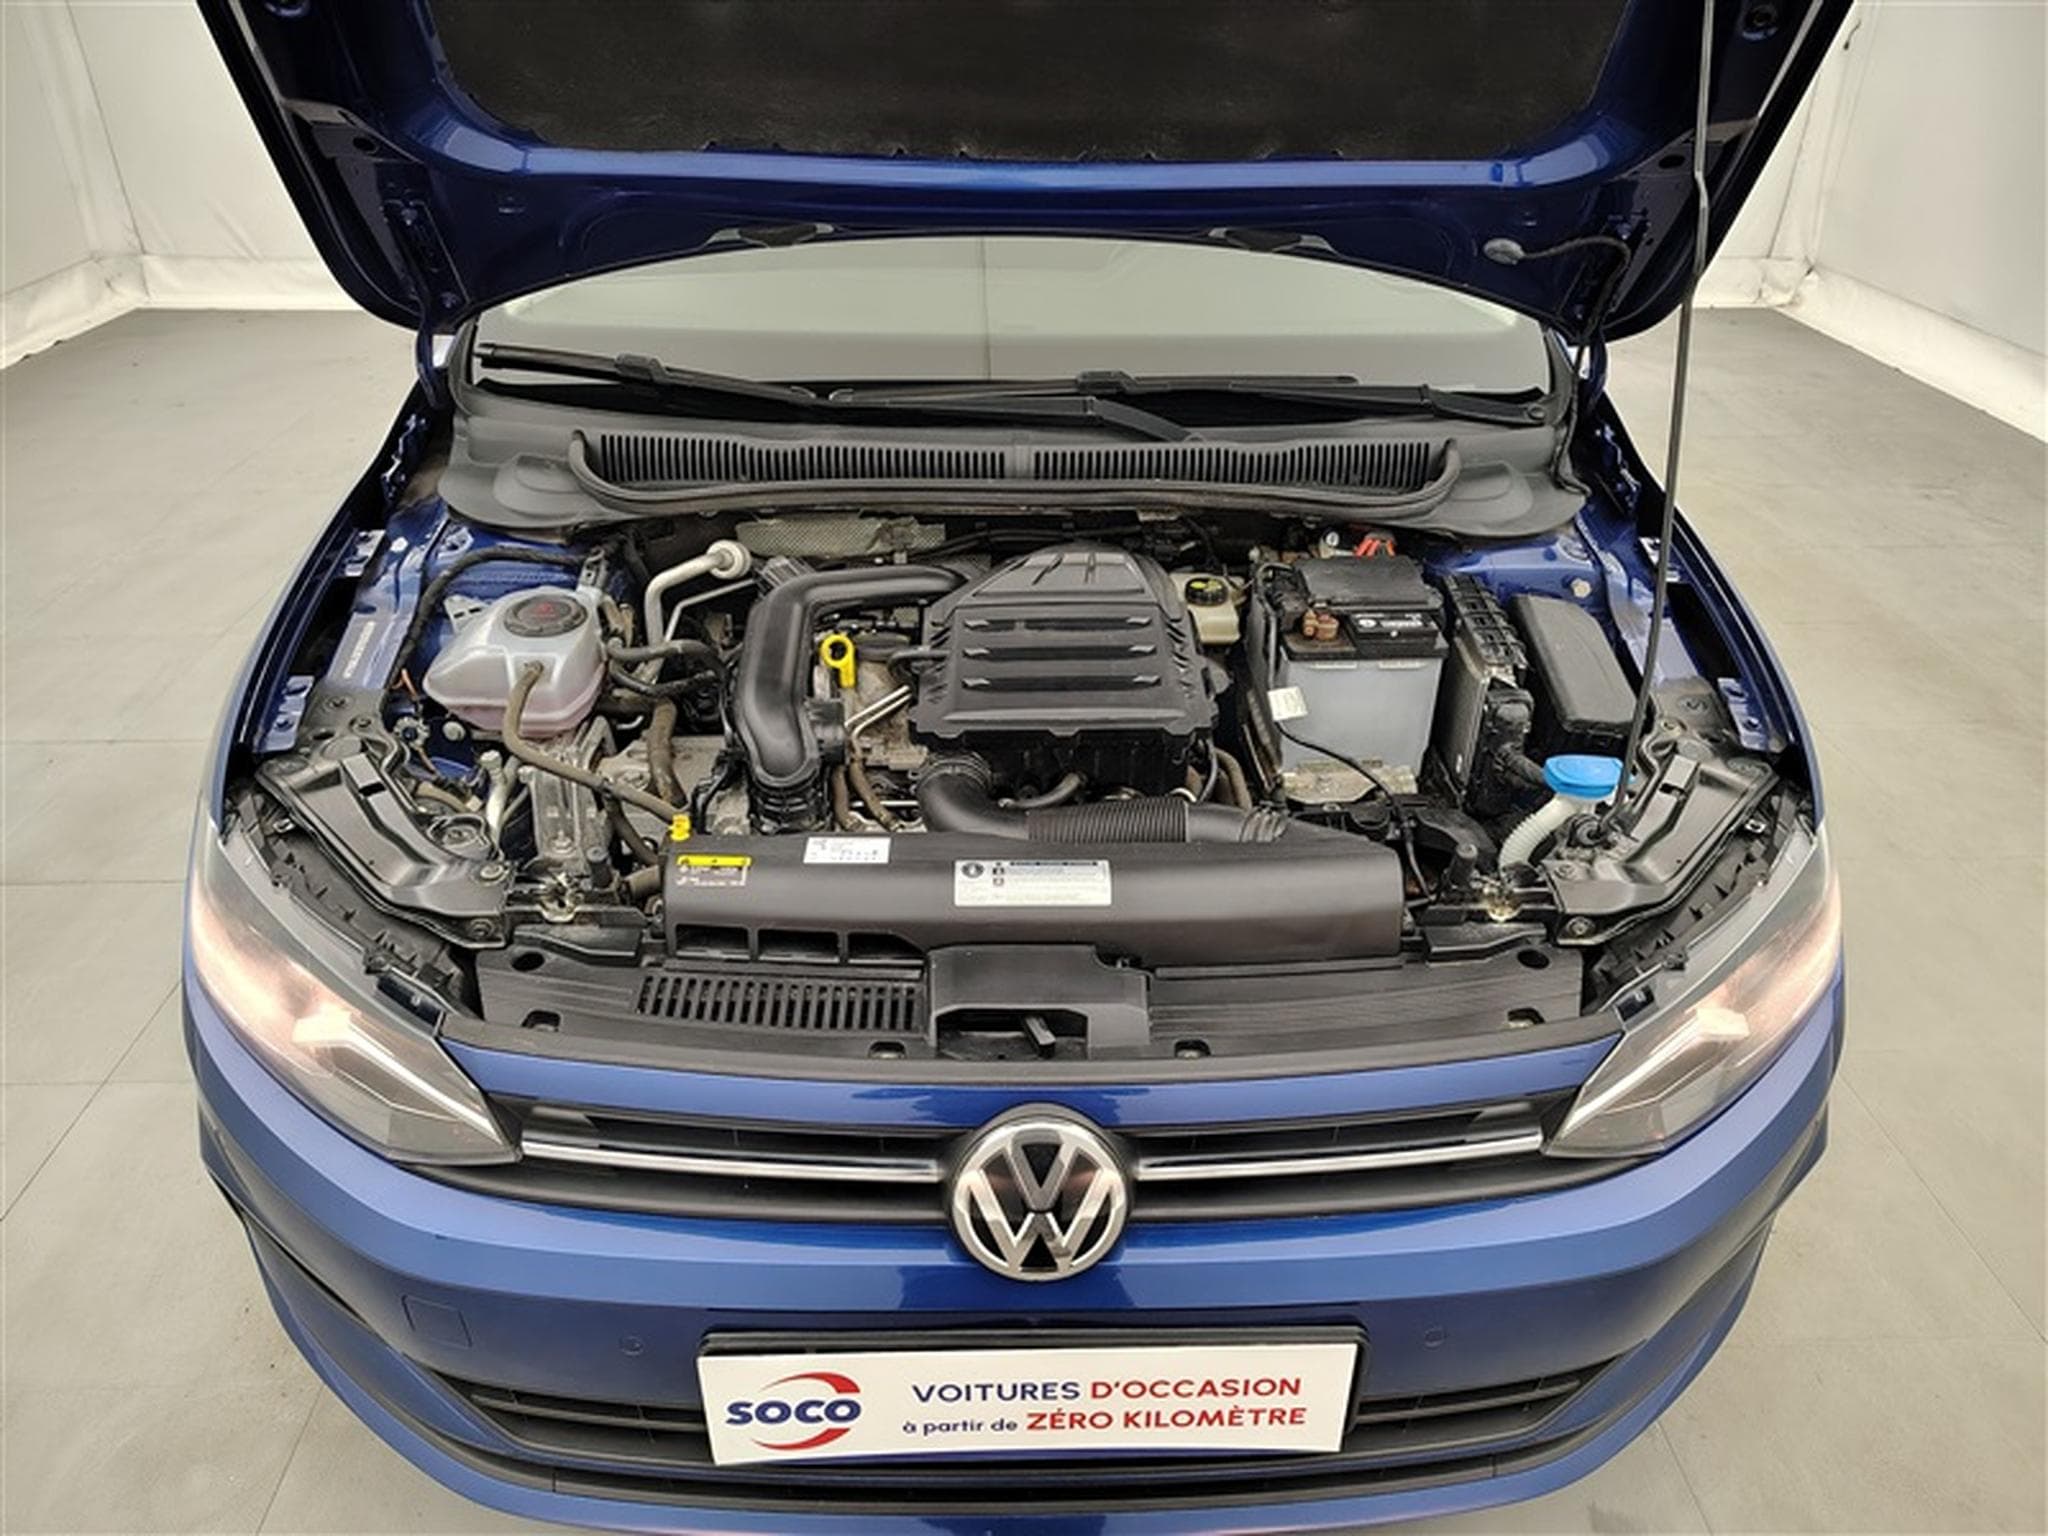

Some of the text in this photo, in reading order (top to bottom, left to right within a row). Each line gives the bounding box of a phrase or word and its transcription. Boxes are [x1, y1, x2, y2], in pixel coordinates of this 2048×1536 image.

[912, 1377, 1301, 1402] VOITURES D'OCCASION
[725, 1399, 862, 1425] SOCO
[902, 1404, 1308, 1437] à partir de ZÉRO KILOMÈTRE
